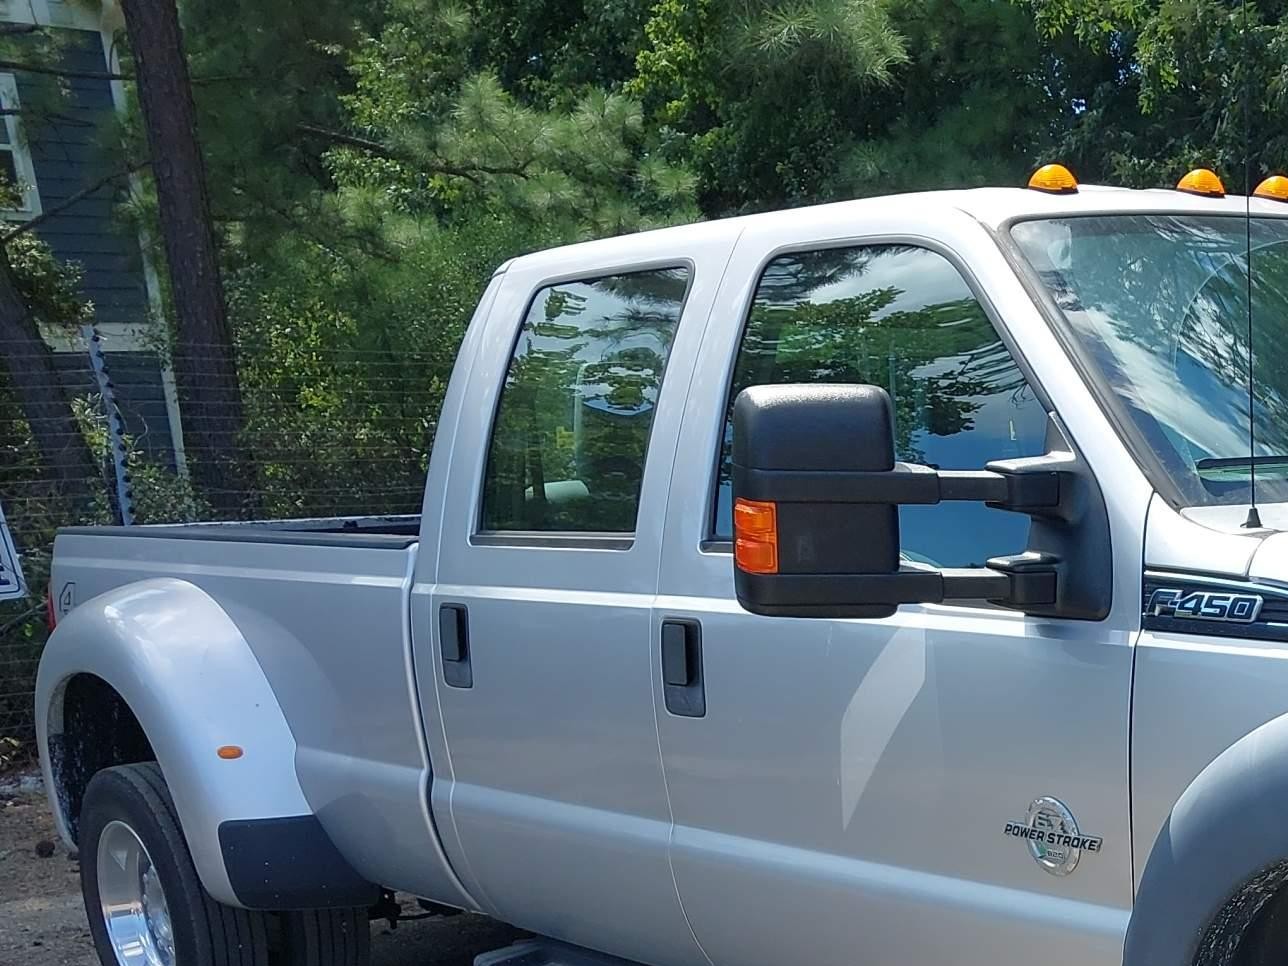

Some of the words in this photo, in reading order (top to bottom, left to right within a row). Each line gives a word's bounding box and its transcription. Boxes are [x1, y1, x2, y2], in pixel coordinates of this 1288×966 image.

[1147, 588, 1264, 624] F-450
[1004, 823, 1045, 842] POWER
[1046, 832, 1098, 852] STROKE
